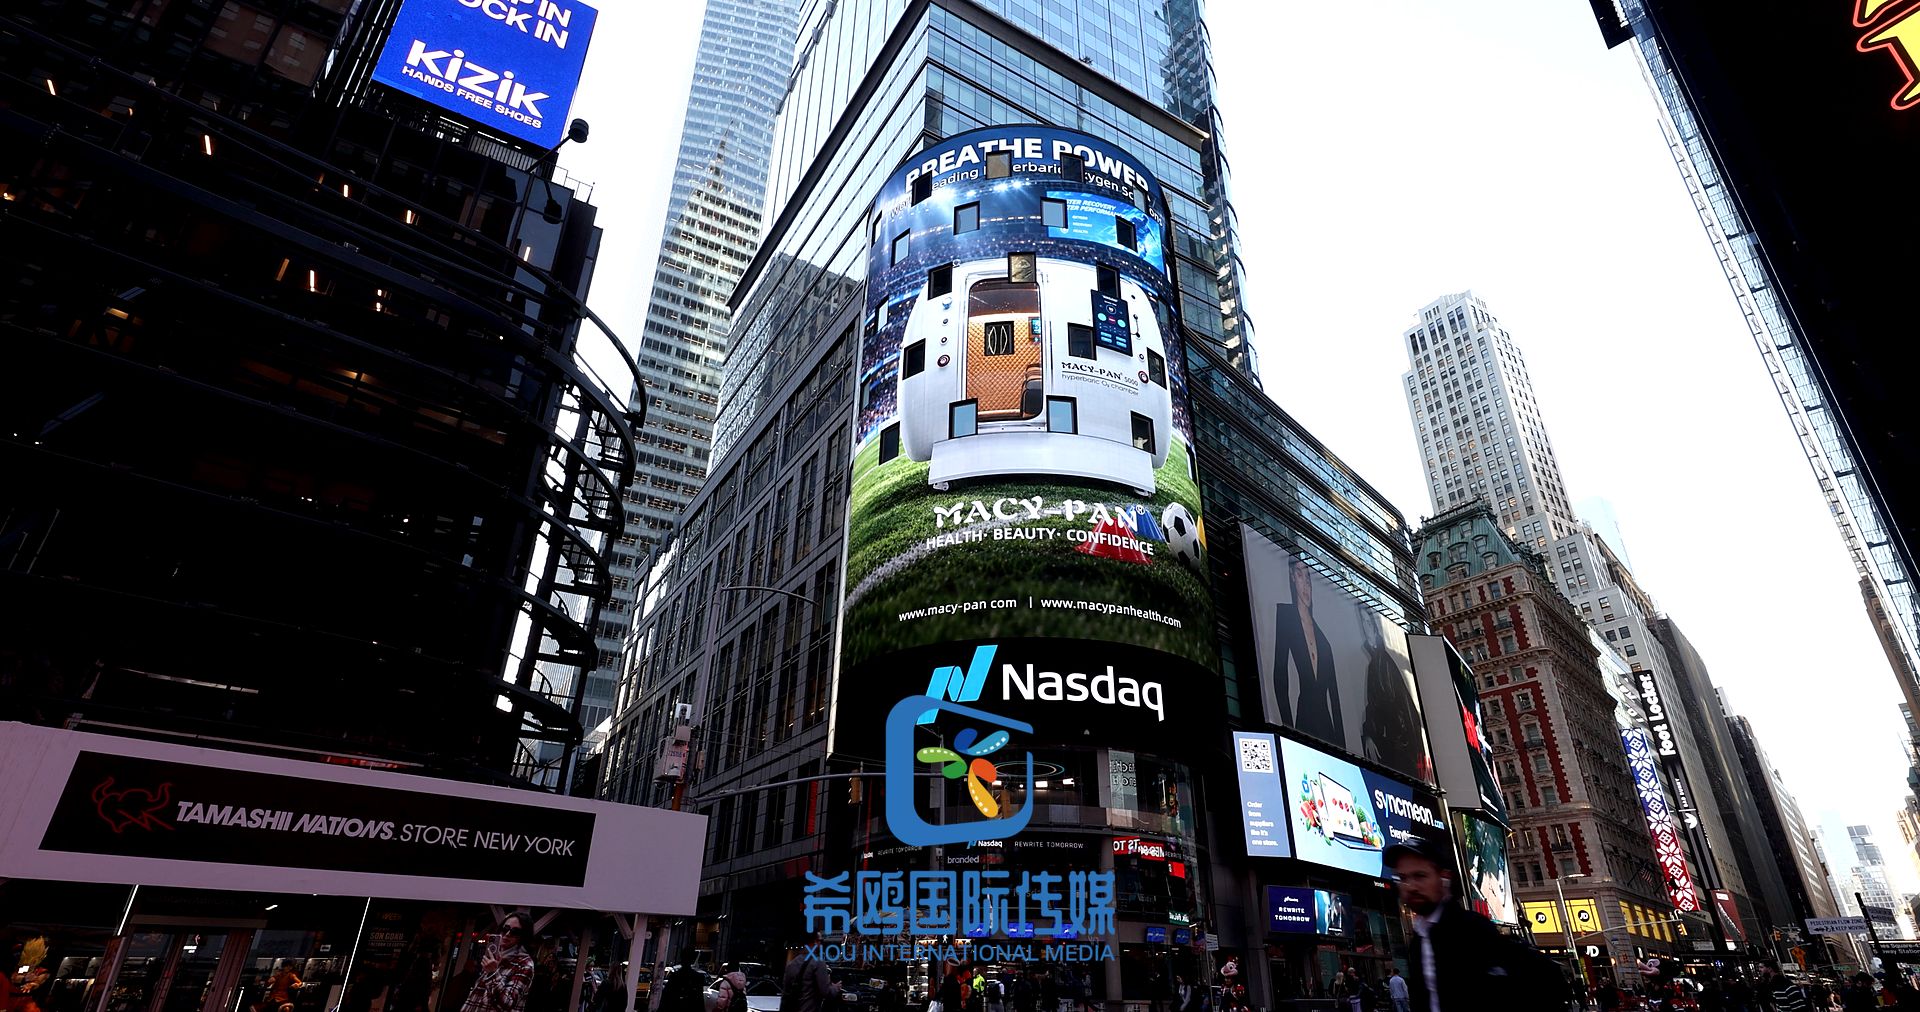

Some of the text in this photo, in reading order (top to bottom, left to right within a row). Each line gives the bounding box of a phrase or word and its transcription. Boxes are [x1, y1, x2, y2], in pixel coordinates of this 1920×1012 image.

[537, 0, 572, 28] IN
[534, 19, 569, 49] IN
[402, 65, 542, 129] HANDS FREE SHOES
[906, 137, 1043, 193] BREATHE
[932, 168, 979, 190] eading
[1085, 172, 1119, 192] ygen
[1066, 528, 1154, 556] CONFIDENCE
[1041, 599, 1182, 628] www.macypanhealth.com
[1002, 663, 1165, 722] Nasdaq
[1653, 723, 1677, 755] Foot
[176, 801, 292, 831] TAMASHII
[399, 823, 468, 849] STORE
[473, 829, 521, 852] NEW
[522, 835, 576, 857] YORK
[978, 840, 1003, 848] Nasdaq
[1046, 841, 1084, 849] TOMORROW
[947, 855, 980, 864] branded
[1585, 945, 1600, 957] JD
